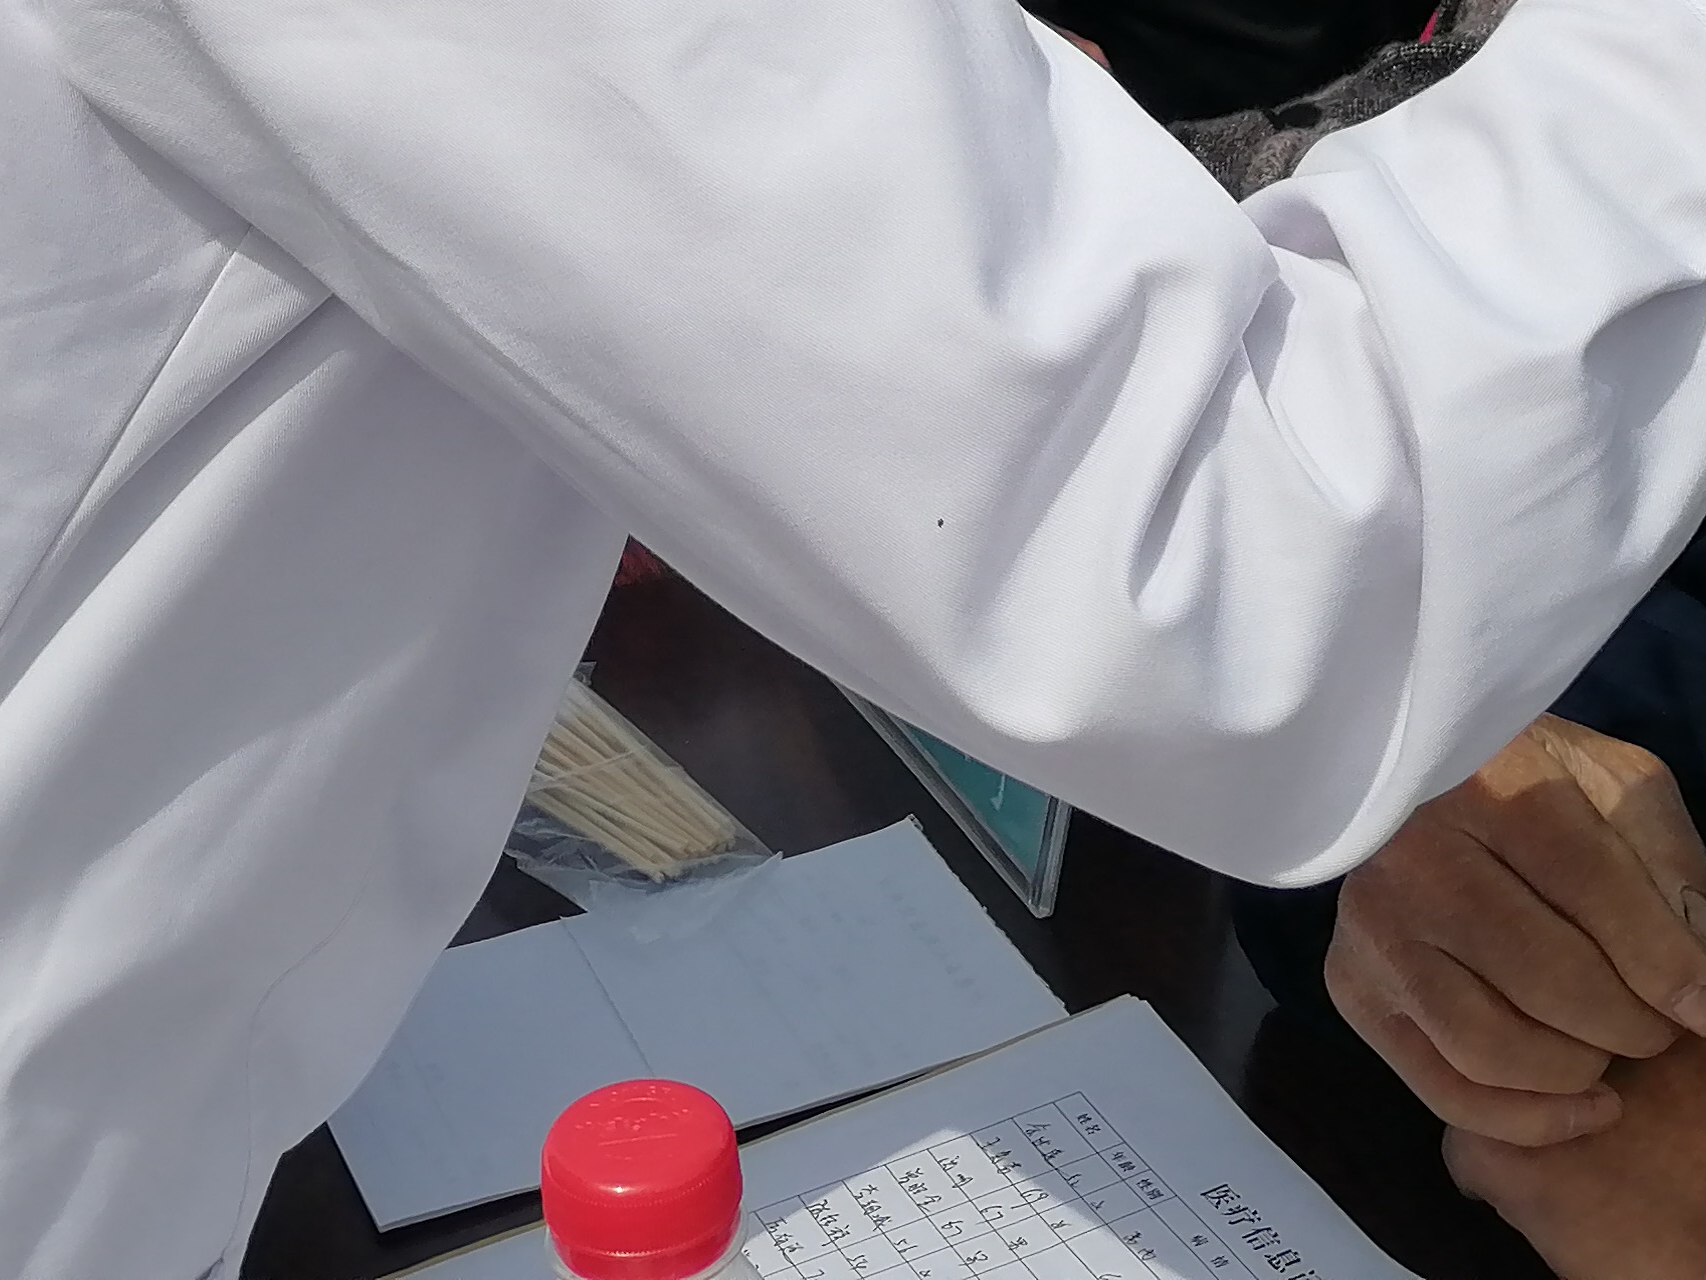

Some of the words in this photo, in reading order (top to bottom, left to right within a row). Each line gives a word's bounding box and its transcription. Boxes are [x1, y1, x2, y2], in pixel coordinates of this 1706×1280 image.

[1077, 1113, 1102, 1135] 姓名
[1112, 1151, 1137, 1172] 年龄
[1136, 1177, 1165, 1201] 性别
[975, 1205, 1004, 1226] 67
[941, 1220, 964, 1239] 67
